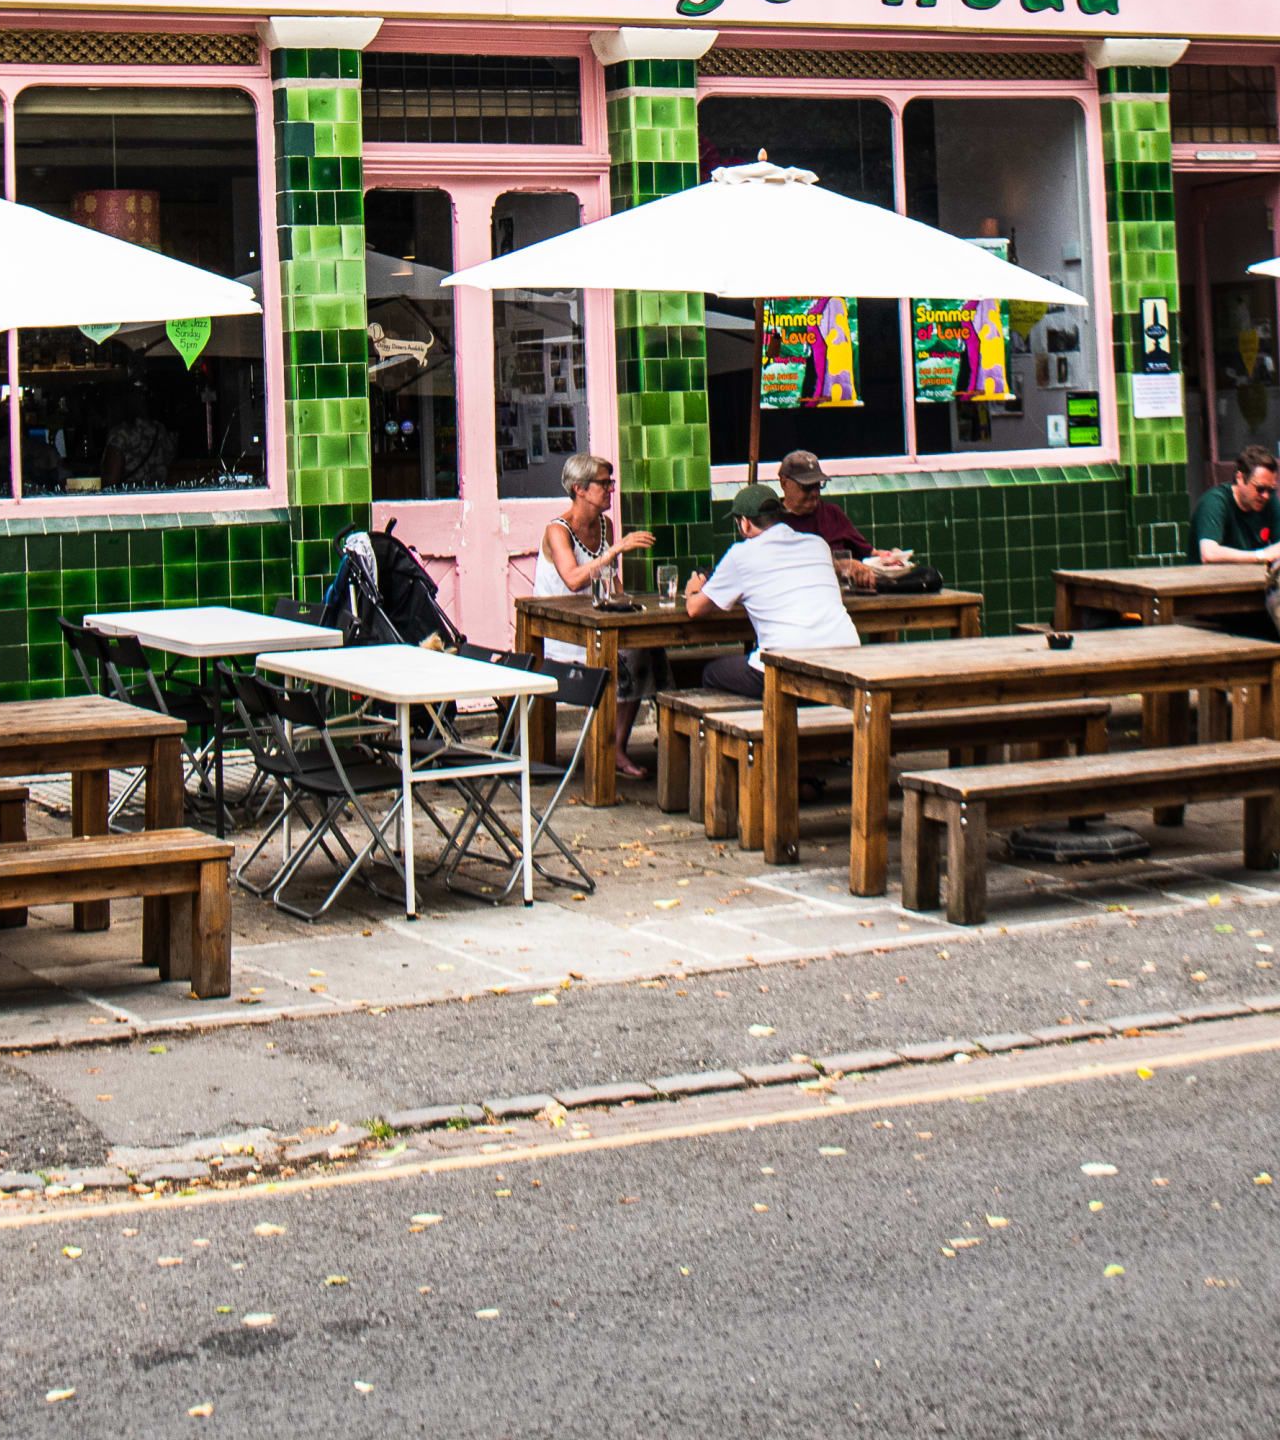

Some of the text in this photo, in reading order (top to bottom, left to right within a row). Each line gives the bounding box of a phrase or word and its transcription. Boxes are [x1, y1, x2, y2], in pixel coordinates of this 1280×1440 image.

[916, 306, 976, 322] Summer
[191, 317, 208, 328] Jazz
[175, 327, 201, 341] Sunday
[782, 329, 816, 344] Love
[917, 324, 970, 340] of Love
[180, 338, 198, 352] 5pm
[770, 395, 778, 403] the
